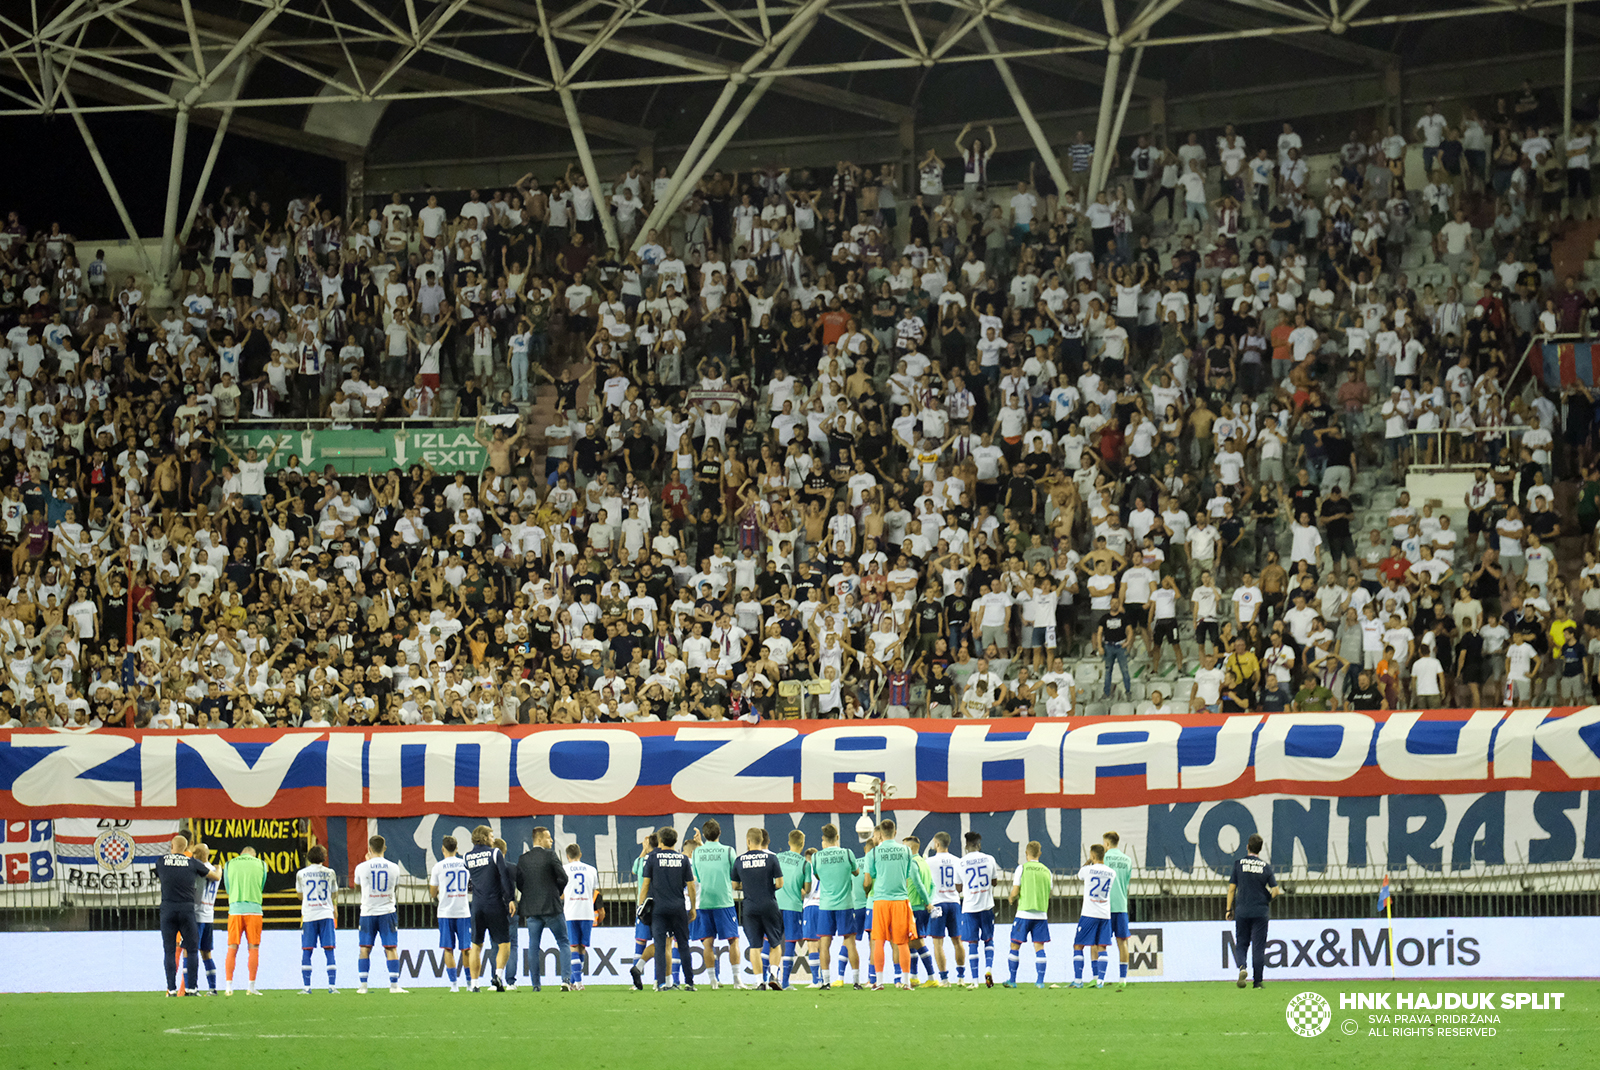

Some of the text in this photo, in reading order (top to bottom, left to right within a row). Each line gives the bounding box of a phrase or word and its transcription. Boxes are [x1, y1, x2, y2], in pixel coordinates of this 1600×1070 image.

[221, 434, 293, 449] ZLAZ
[423, 450, 480, 466] EXIT
[11, 706, 1600, 808] ŽIVIMO ZA HAJDUK
[204, 819, 223, 837] UZ
[1146, 791, 1506, 876] KONTRA
[466, 851, 492, 860] macron
[659, 859, 682, 867] HAJDUK
[740, 853, 769, 861] macron
[742, 859, 766, 869] HAJDUK
[371, 870, 389, 892] 10
[445, 870, 468, 892] 20
[574, 873, 585, 895] 3
[940, 866, 954, 887] 19
[965, 865, 990, 889] 25
[1089, 876, 1111, 898] 24
[306, 879, 329, 901] 23
